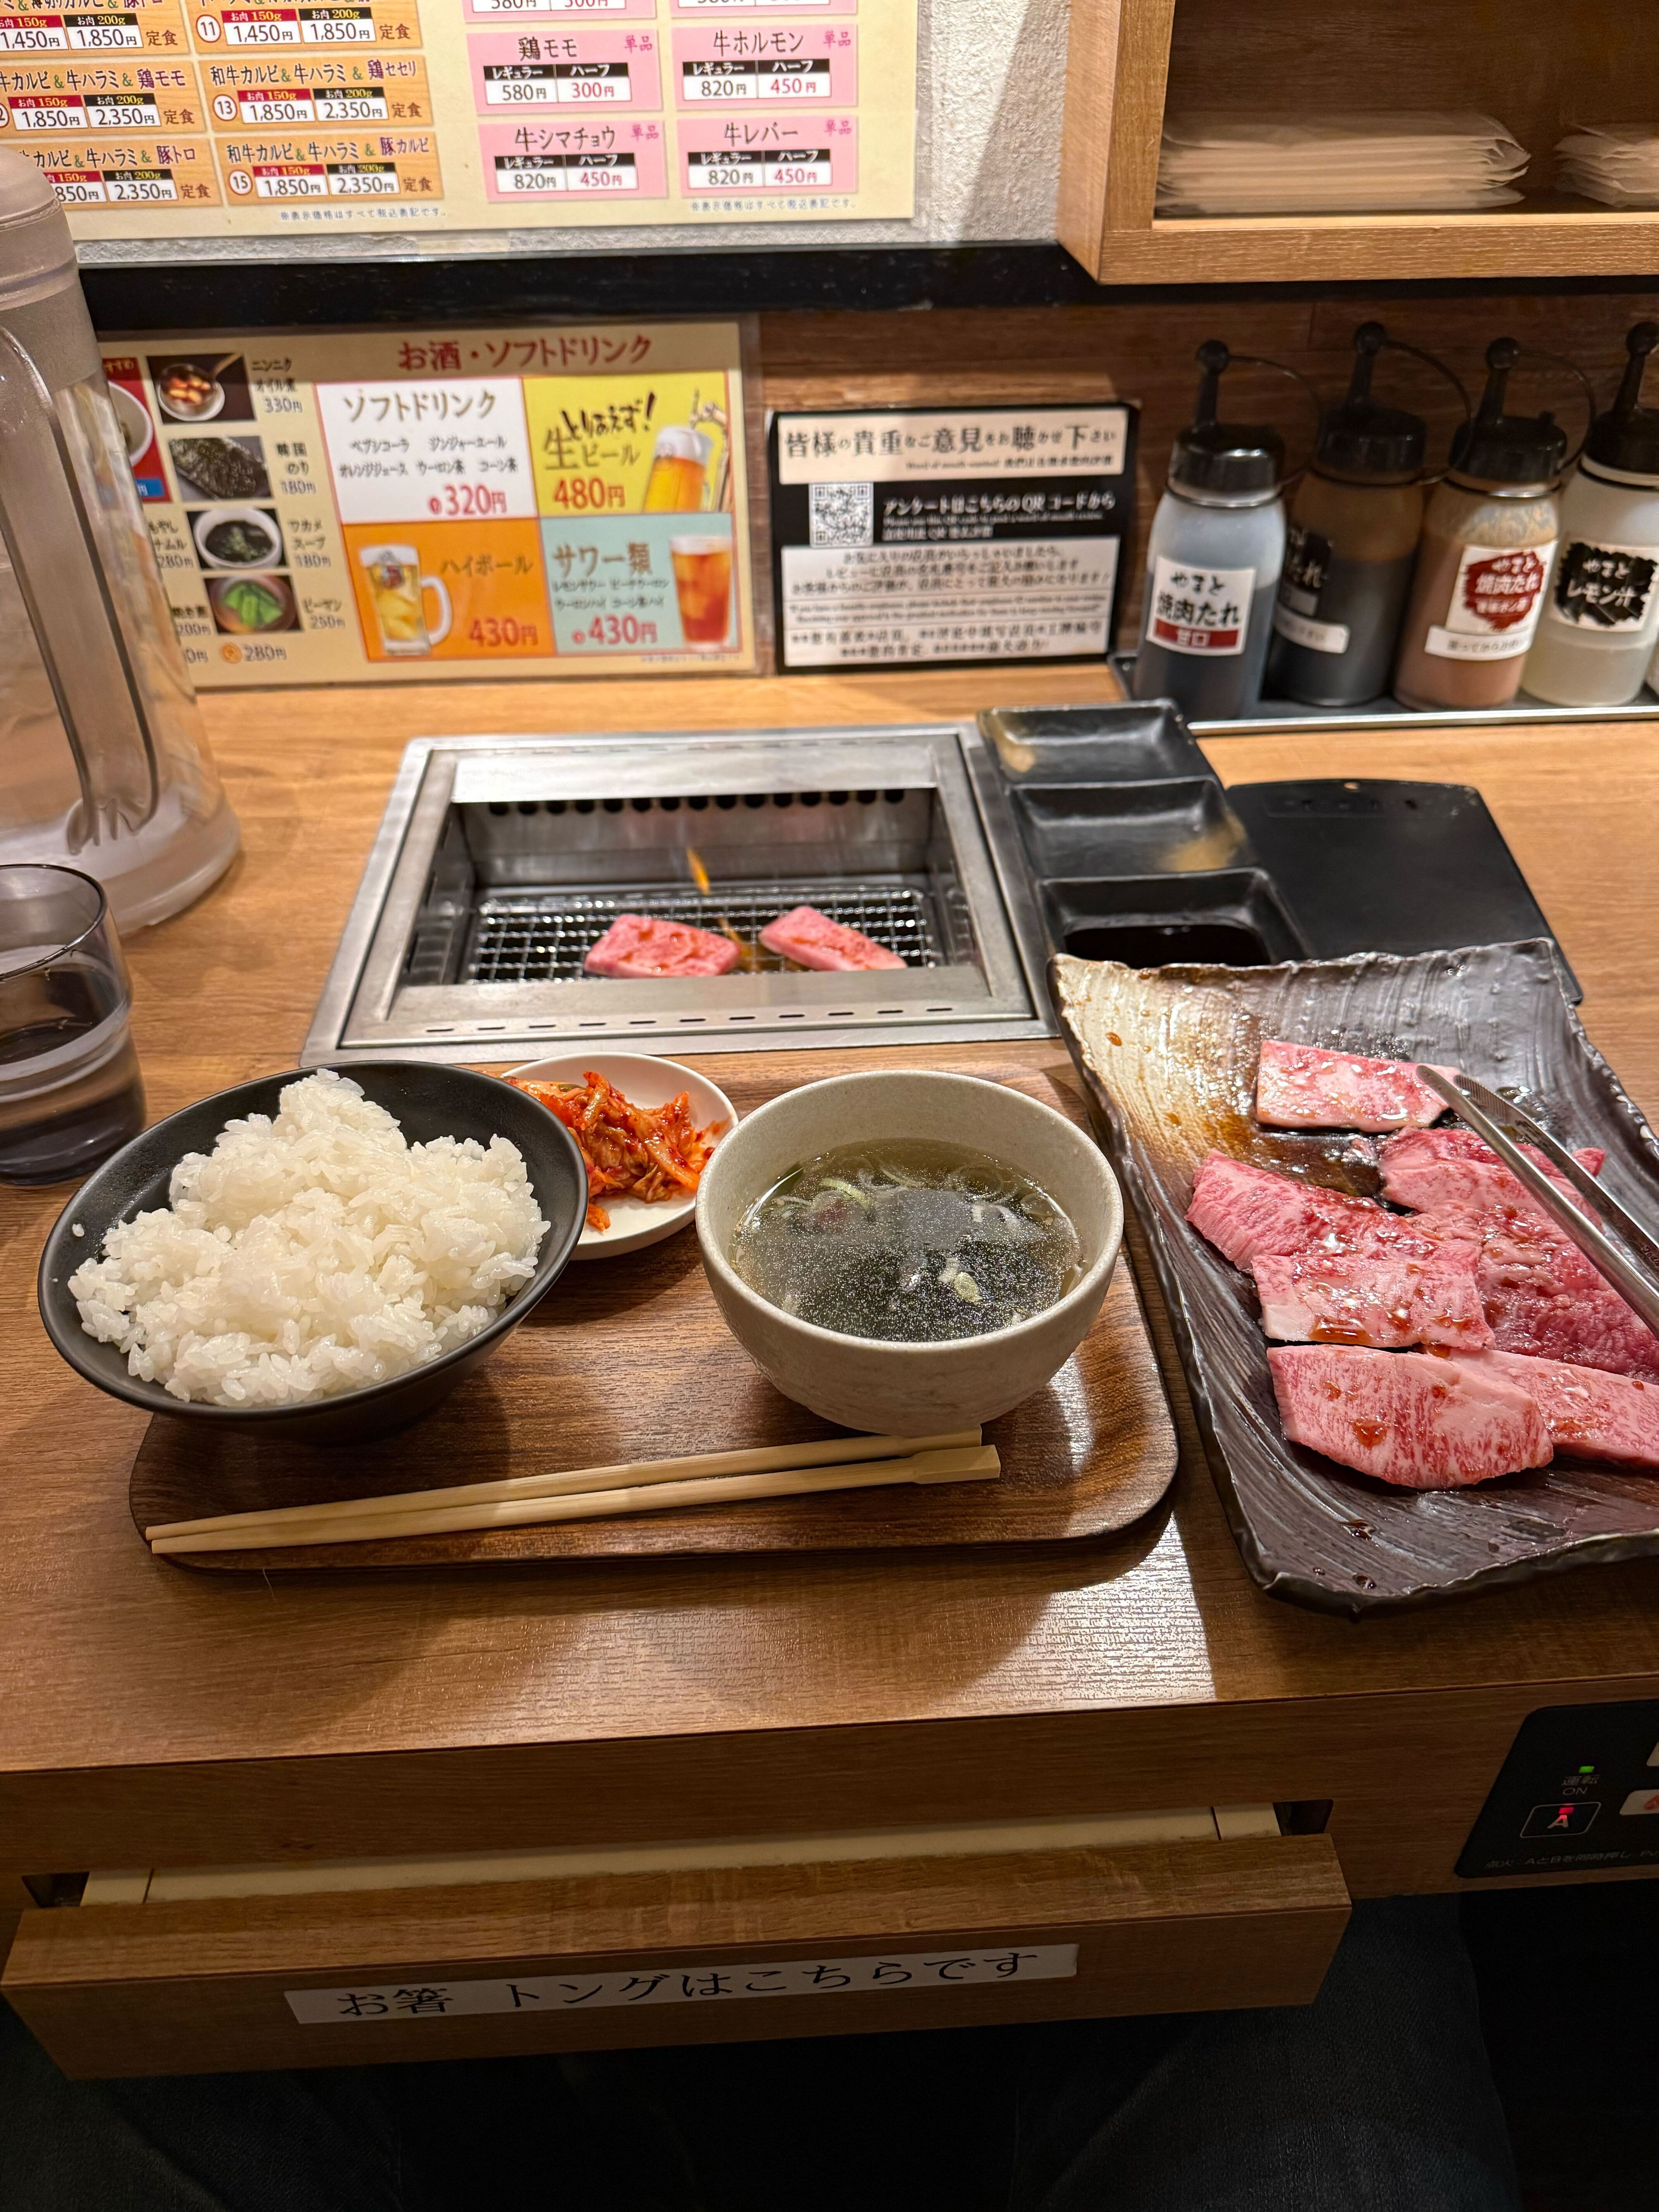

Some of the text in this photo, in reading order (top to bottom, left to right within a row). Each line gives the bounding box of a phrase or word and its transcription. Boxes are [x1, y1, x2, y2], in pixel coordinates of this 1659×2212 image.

[17, 17, 47, 27] 150g
[77, 16, 95, 26] お肉
[97, 15, 126, 25] 200g
[201, 9, 360, 36] 11 お肉 150g お肉 200g
[0, 29, 177, 49] 1,450円 1,850円 定食
[234, 23, 410, 42] 1,450円 1,850円 定食
[518, 35, 652, 61] 鶏モモ 単品
[713, 30, 851, 57] 牛ホルモン 単品
[492, 64, 610, 80] レギュラー ハーフ
[692, 60, 813, 76] レギュラー ハーフ
[502, 82, 614, 101] 580円 300円
[701, 78, 816, 96] 820円 450円
[18, 98, 35, 107] お肉
[39, 98, 68, 107] 150g
[96, 96, 114, 105] お肉
[116, 95, 144, 105] 200g
[217, 89, 373, 115] 13 お肉 150g お肉 200g
[22, 107, 194, 128] 1,850円 2,350円 定食
[250, 102, 422, 121] 1,850円 2,350円 定食
[515, 126, 615, 152] 牛シマチョウ
[724, 122, 798, 147] 牛レバー
[58, 172, 86, 182] 150g
[116, 172, 132, 180] お肉
[134, 170, 161, 180] 200g
[233, 175, 248, 189] 15
[282, 166, 310, 175] 150g
[514, 171, 622, 189] 820円 450円
[708, 168, 817, 185] 820円 450円
[55, 183, 211, 201] 850円 2,350円 定食
[265, 177, 433, 196] 1,850円 2,350円 定食
[398, 335, 652, 371] お酒・ソフトドリンク
[344, 388, 496, 423] ソフトドリンク
[544, 426, 641, 470] 生ビール
[444, 483, 507, 515] 320円
[554, 477, 625, 510] 480円
[441, 542, 652, 577] ハイボール サワー類
[469, 617, 538, 647] 430円
[589, 613, 658, 645] 430円
[1563, 1787, 1588, 1796] ON
[1547, 1814, 1569, 1829] A
[337, 1952, 1038, 2016] お箸 トングはこちらです
